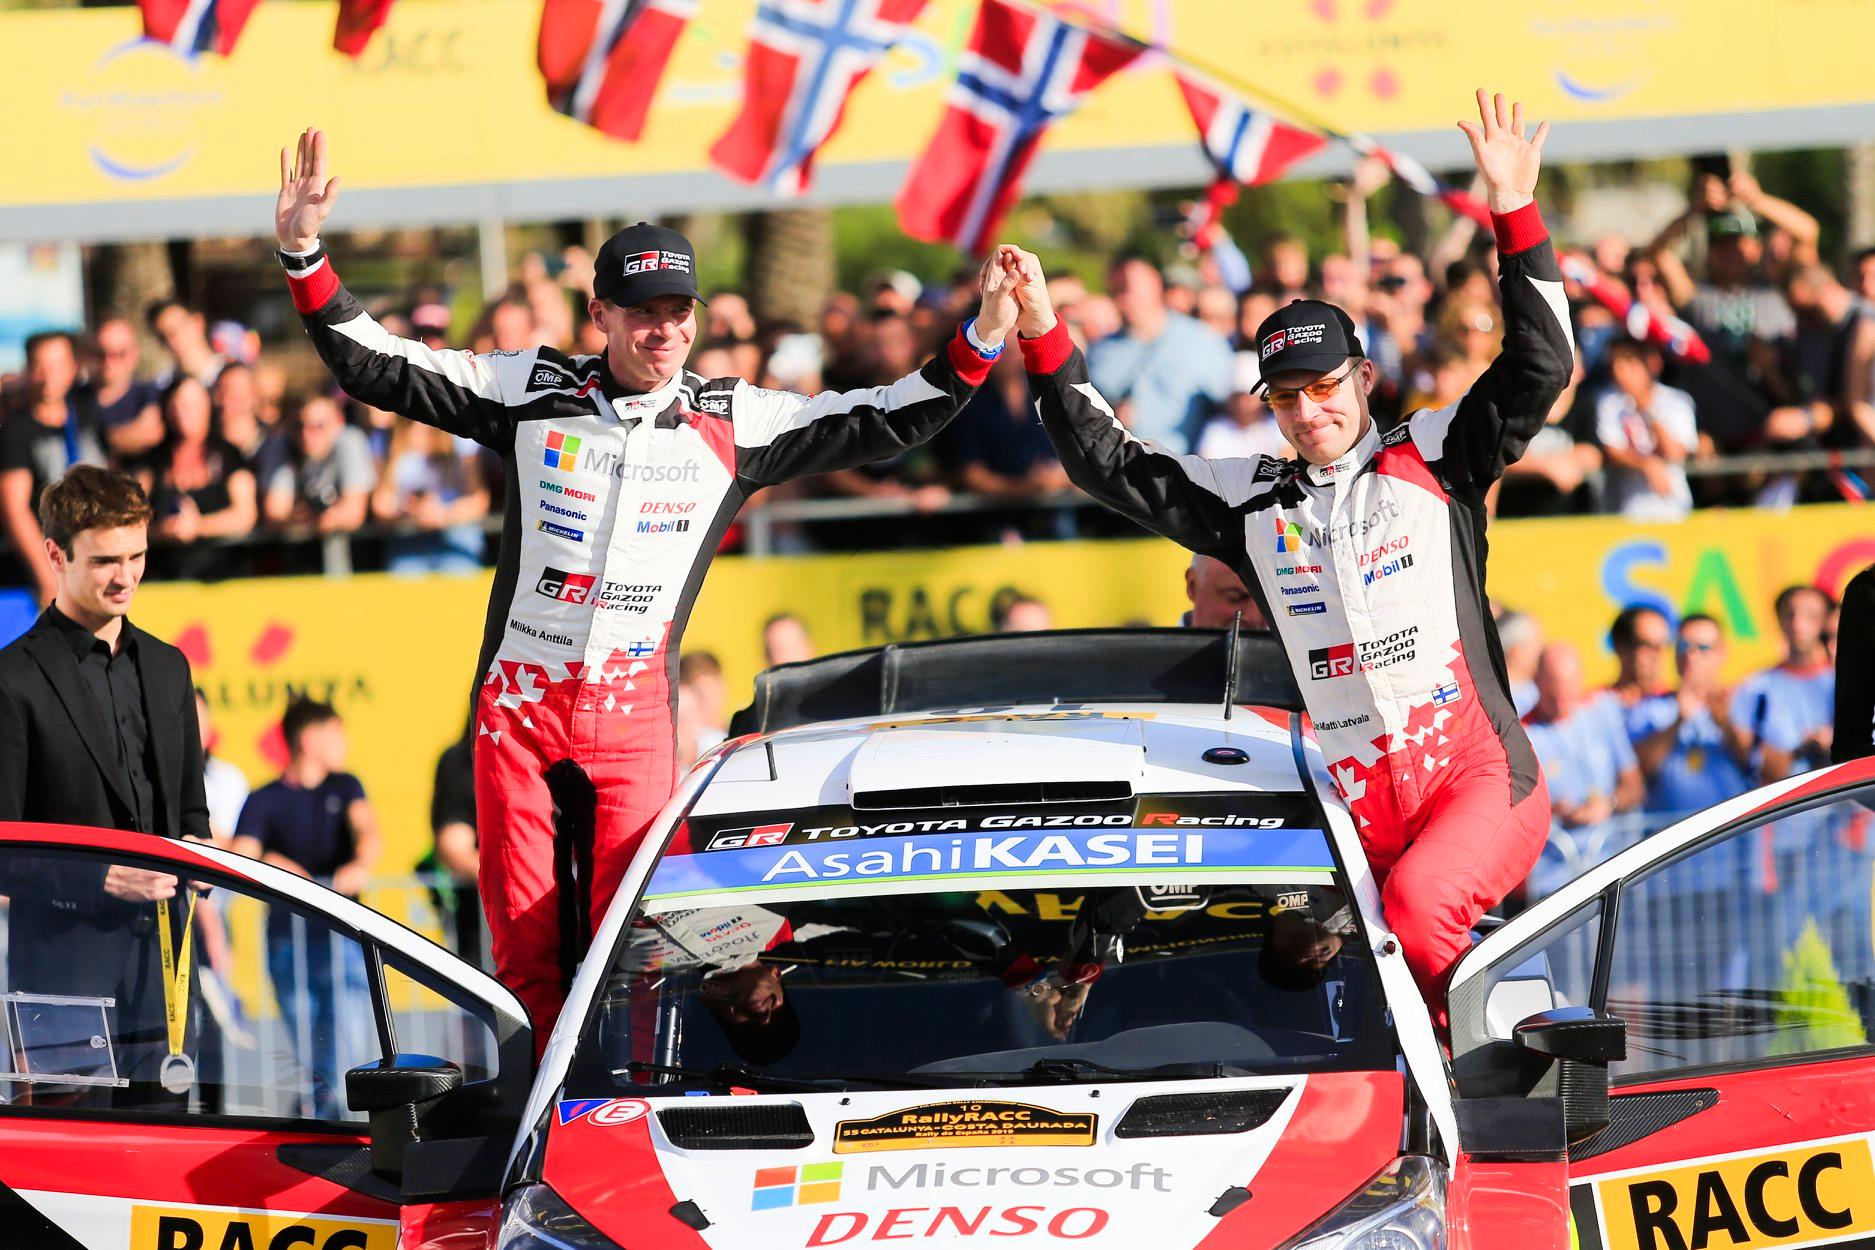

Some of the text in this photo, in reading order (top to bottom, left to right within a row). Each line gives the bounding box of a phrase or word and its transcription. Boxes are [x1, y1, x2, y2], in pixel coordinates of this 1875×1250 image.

[661, 251, 690, 261] TOYOTA
[661, 258, 689, 267] GAZOO
[625, 256, 659, 274] GR
[660, 263, 689, 274] Racing
[1287, 323, 1326, 335] TOYOTA
[1287, 330, 1323, 340] GAZOO
[1262, 336, 1285, 359] GR
[1289, 336, 1322, 347] Racing
[535, 372, 563, 384] OMP
[700, 400, 728, 413] OMP
[584, 448, 700, 482] Microsoft
[540, 480, 596, 502] DMG MORI
[540, 500, 587, 521] Panasonic
[639, 502, 697, 514] DENSO
[547, 525, 580, 539] MICHELIN
[637, 520, 675, 533] Mobil
[1359, 535, 1409, 566] DENSO
[1276, 565, 1322, 576] DMG MORI
[1363, 560, 1400, 585] Mobil
[540, 579, 589, 603] GR
[605, 581, 662, 593] TOYOTA
[1281, 584, 1320, 596] Panasonic
[600, 592, 654, 603] GAZOO
[597, 600, 648, 614] Racing
[510, 619, 573, 646] Miikka Anttila
[1359, 625, 1419, 651] TOYOTA
[1361, 638, 1415, 662] GAZOO
[1311, 656, 1353, 679] GR
[1361, 650, 1416, 671] Racing
[1338, 714, 1370, 728] Latvala
[711, 813, 1285, 850] GR TOYOTA GAZOO Racing
[1278, 893, 1308, 910] OMP
[960, 1104, 982, 1112] 10
[902, 1111, 1031, 1125] RallyRACC
[867, 1163, 1172, 1193] Microsoft
[1628, 1152, 1853, 1250] RACC
[805, 1205, 1110, 1248] DENSO
